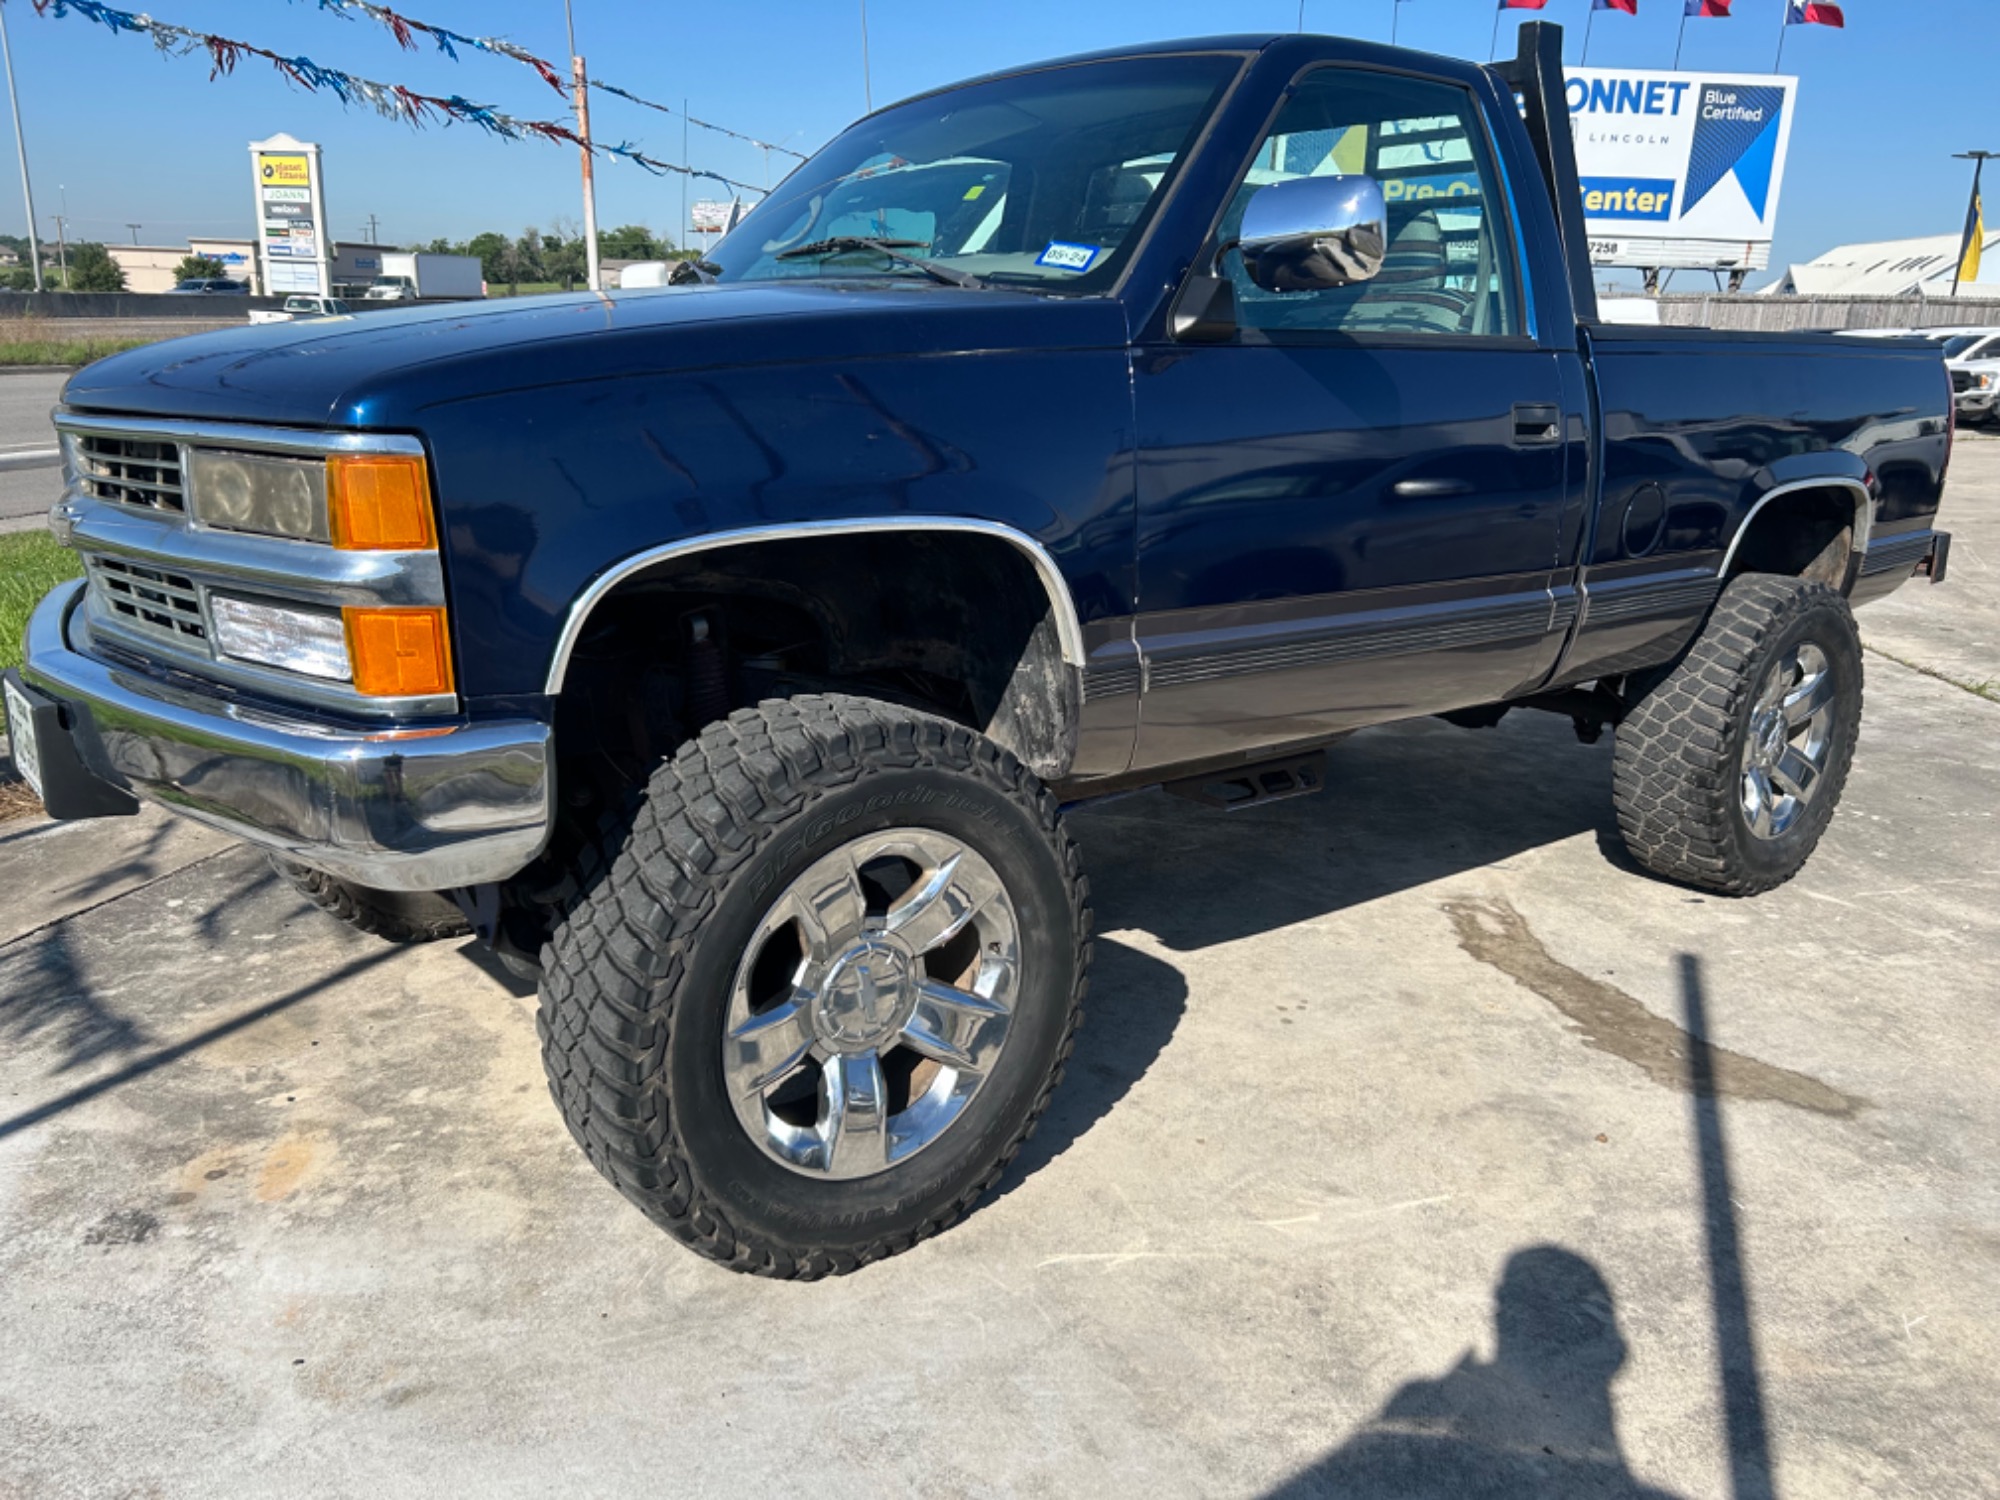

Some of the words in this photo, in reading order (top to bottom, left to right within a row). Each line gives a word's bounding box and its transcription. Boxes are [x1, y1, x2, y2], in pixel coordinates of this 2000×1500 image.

[1565, 77, 1690, 115] ONNET
[1705, 89, 1737, 104] Blue
[1702, 104, 1763, 122] Certified
[1588, 132, 1669, 144] LINCOLN
[1580, 186, 1669, 213] enter
